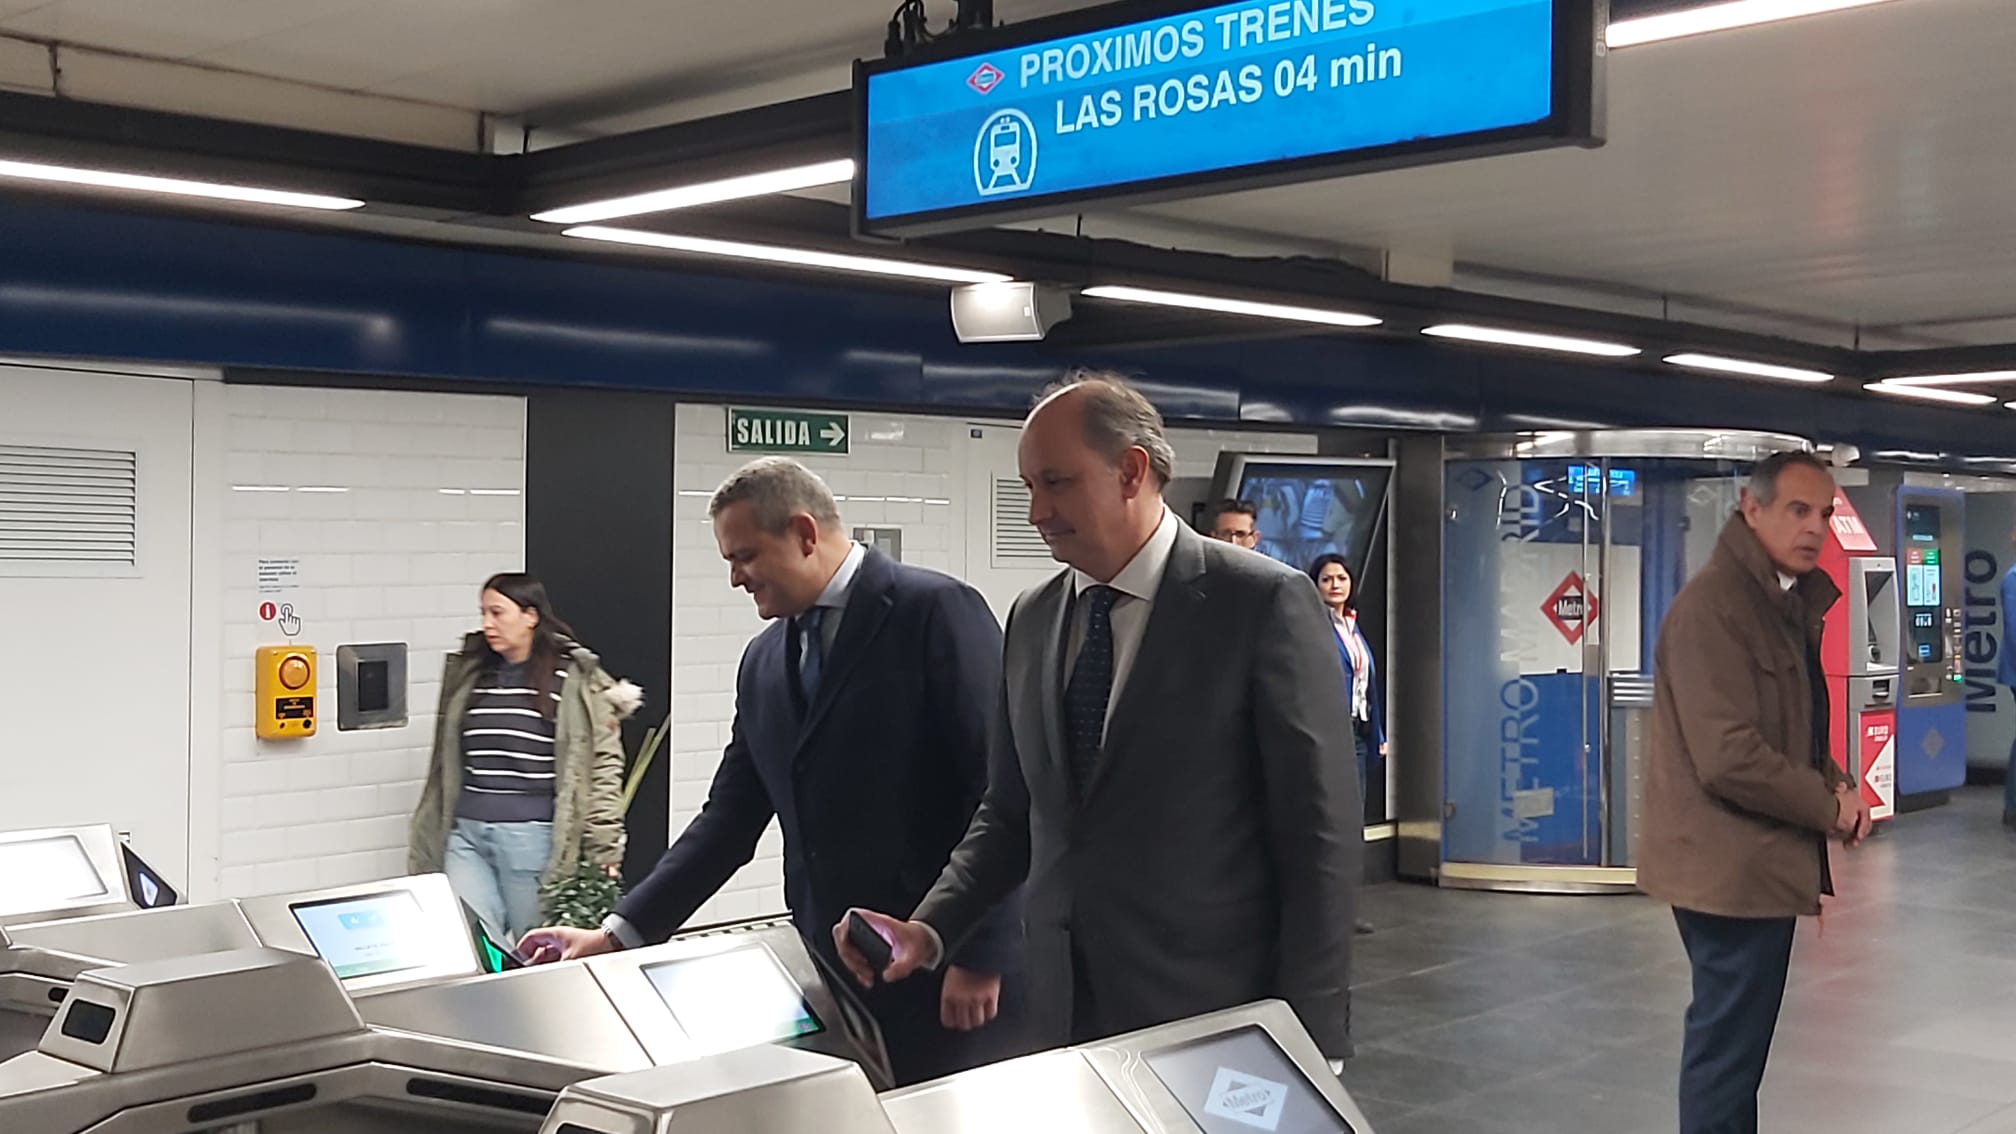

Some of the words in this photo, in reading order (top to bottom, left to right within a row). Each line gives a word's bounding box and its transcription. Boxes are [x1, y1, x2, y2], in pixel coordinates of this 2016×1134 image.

[1020, 20, 1204, 88] PROXIMOS
[1215, 0, 1375, 50] TRENES
[1056, 90, 1122, 134] LAS
[1133, 64, 1263, 121] ROSAS
[1274, 55, 1318, 97] 04
[1330, 43, 1402, 88] min
[737, 418, 810, 446] SALIDA
[1831, 515, 1866, 534] ATM
[1964, 549, 1998, 713] Metro
[1501, 678, 1540, 842] METRO
